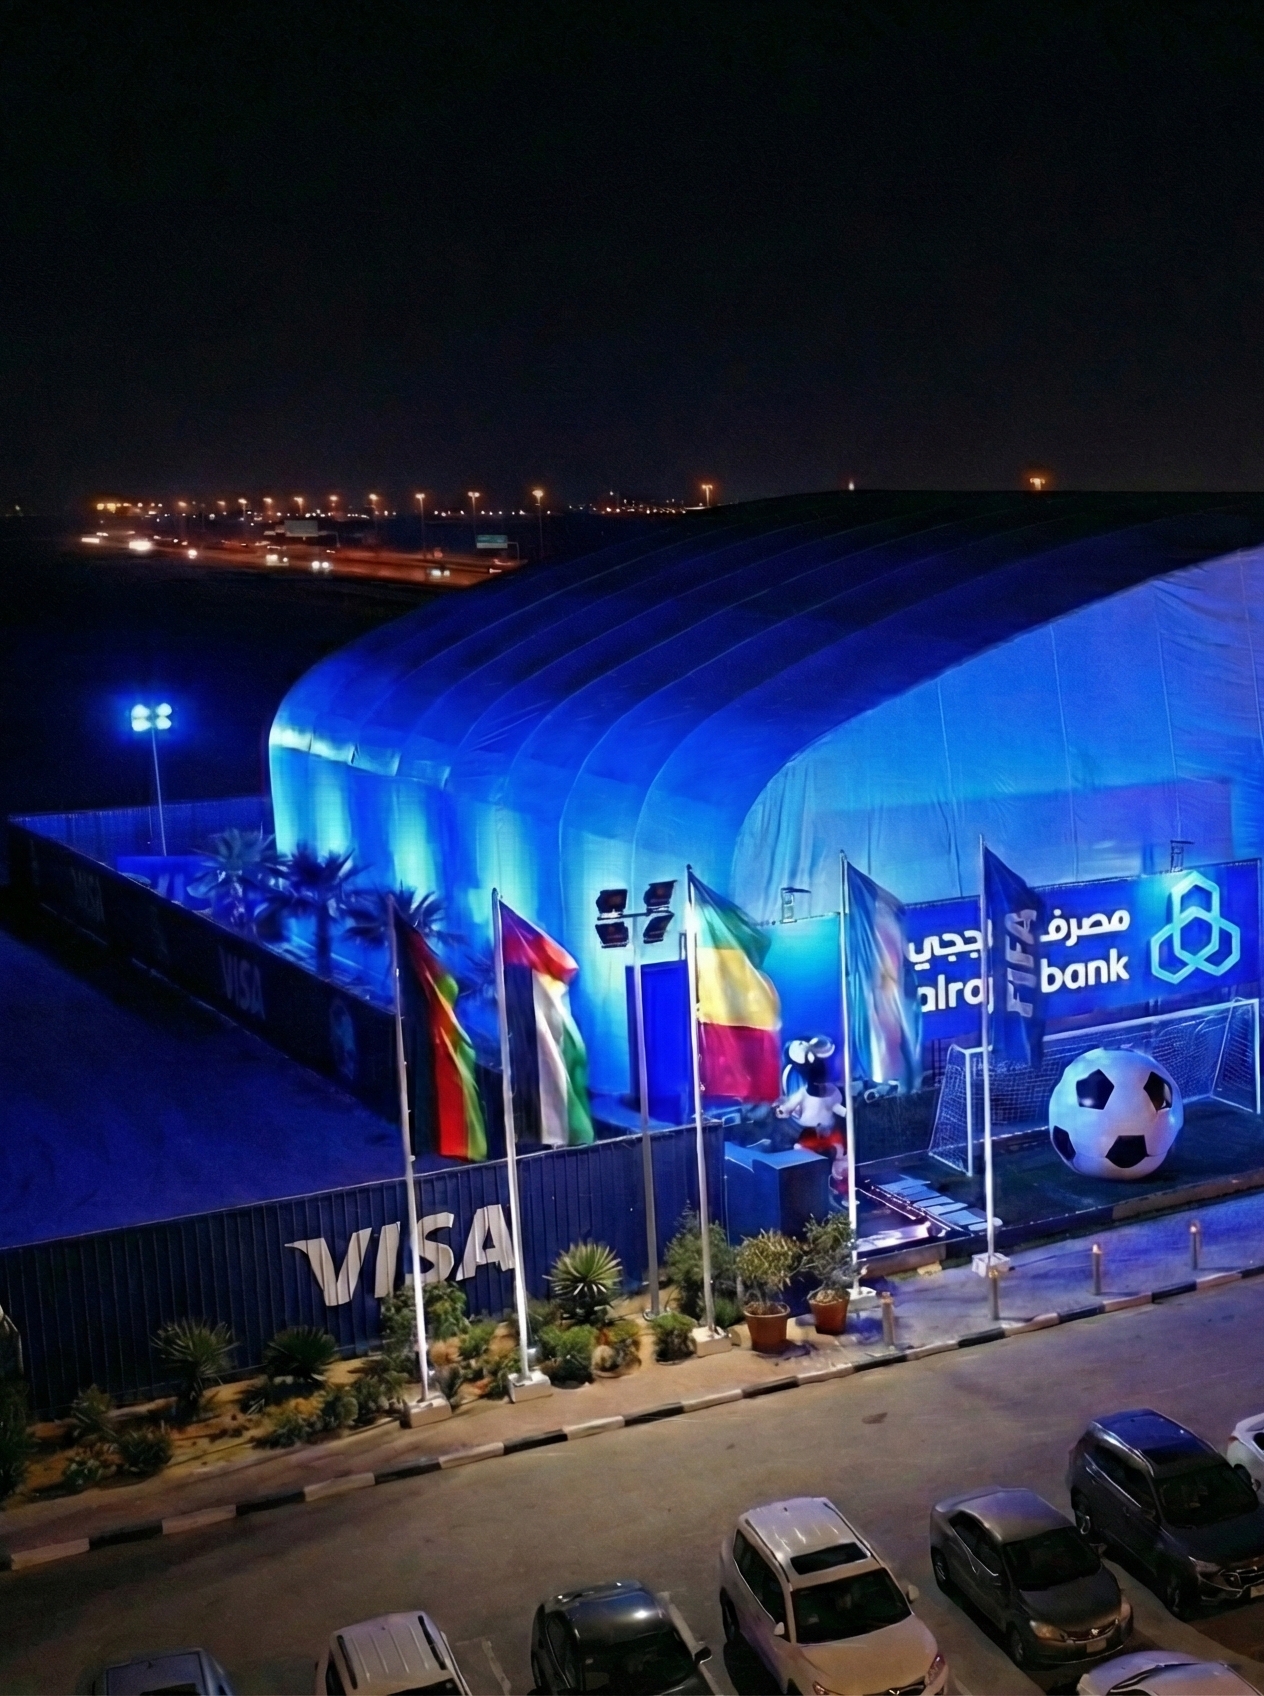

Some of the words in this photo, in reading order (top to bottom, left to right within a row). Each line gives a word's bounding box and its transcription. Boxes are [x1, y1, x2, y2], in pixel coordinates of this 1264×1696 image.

[1004, 908, 1037, 1018] FIFA
[1039, 908, 1131, 947] مصرف
[218, 945, 266, 1020] VISA
[1039, 947, 1131, 994] bank
[284, 1203, 517, 1307] VISA
